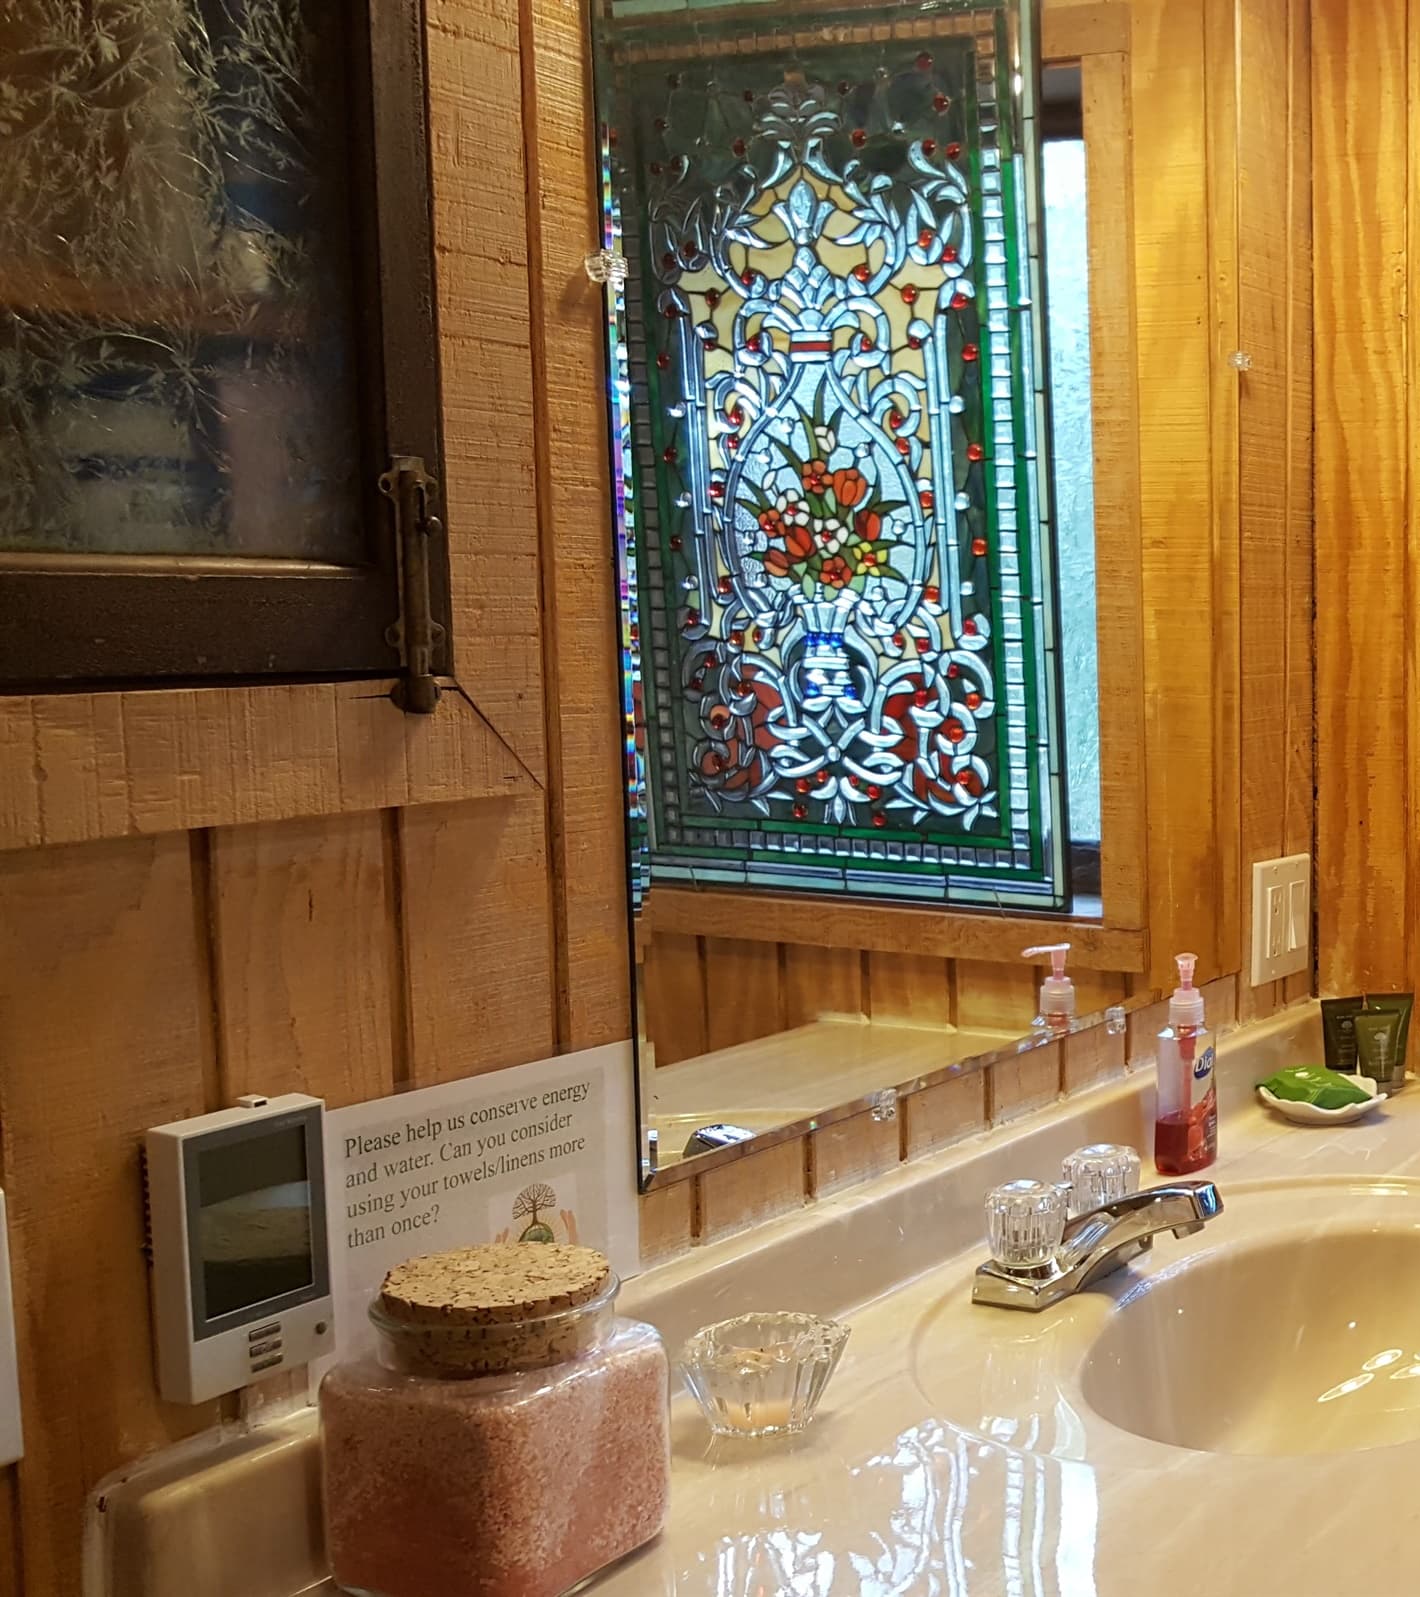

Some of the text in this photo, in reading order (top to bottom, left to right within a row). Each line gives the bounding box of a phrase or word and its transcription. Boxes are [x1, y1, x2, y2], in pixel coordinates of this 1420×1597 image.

[345, 1081, 590, 1158] Please help us conserve energy
[345, 1112, 573, 1188] and water. Can you consider
[347, 1137, 585, 1218] using your towels/linens more
[348, 1203, 440, 1249] than once?
